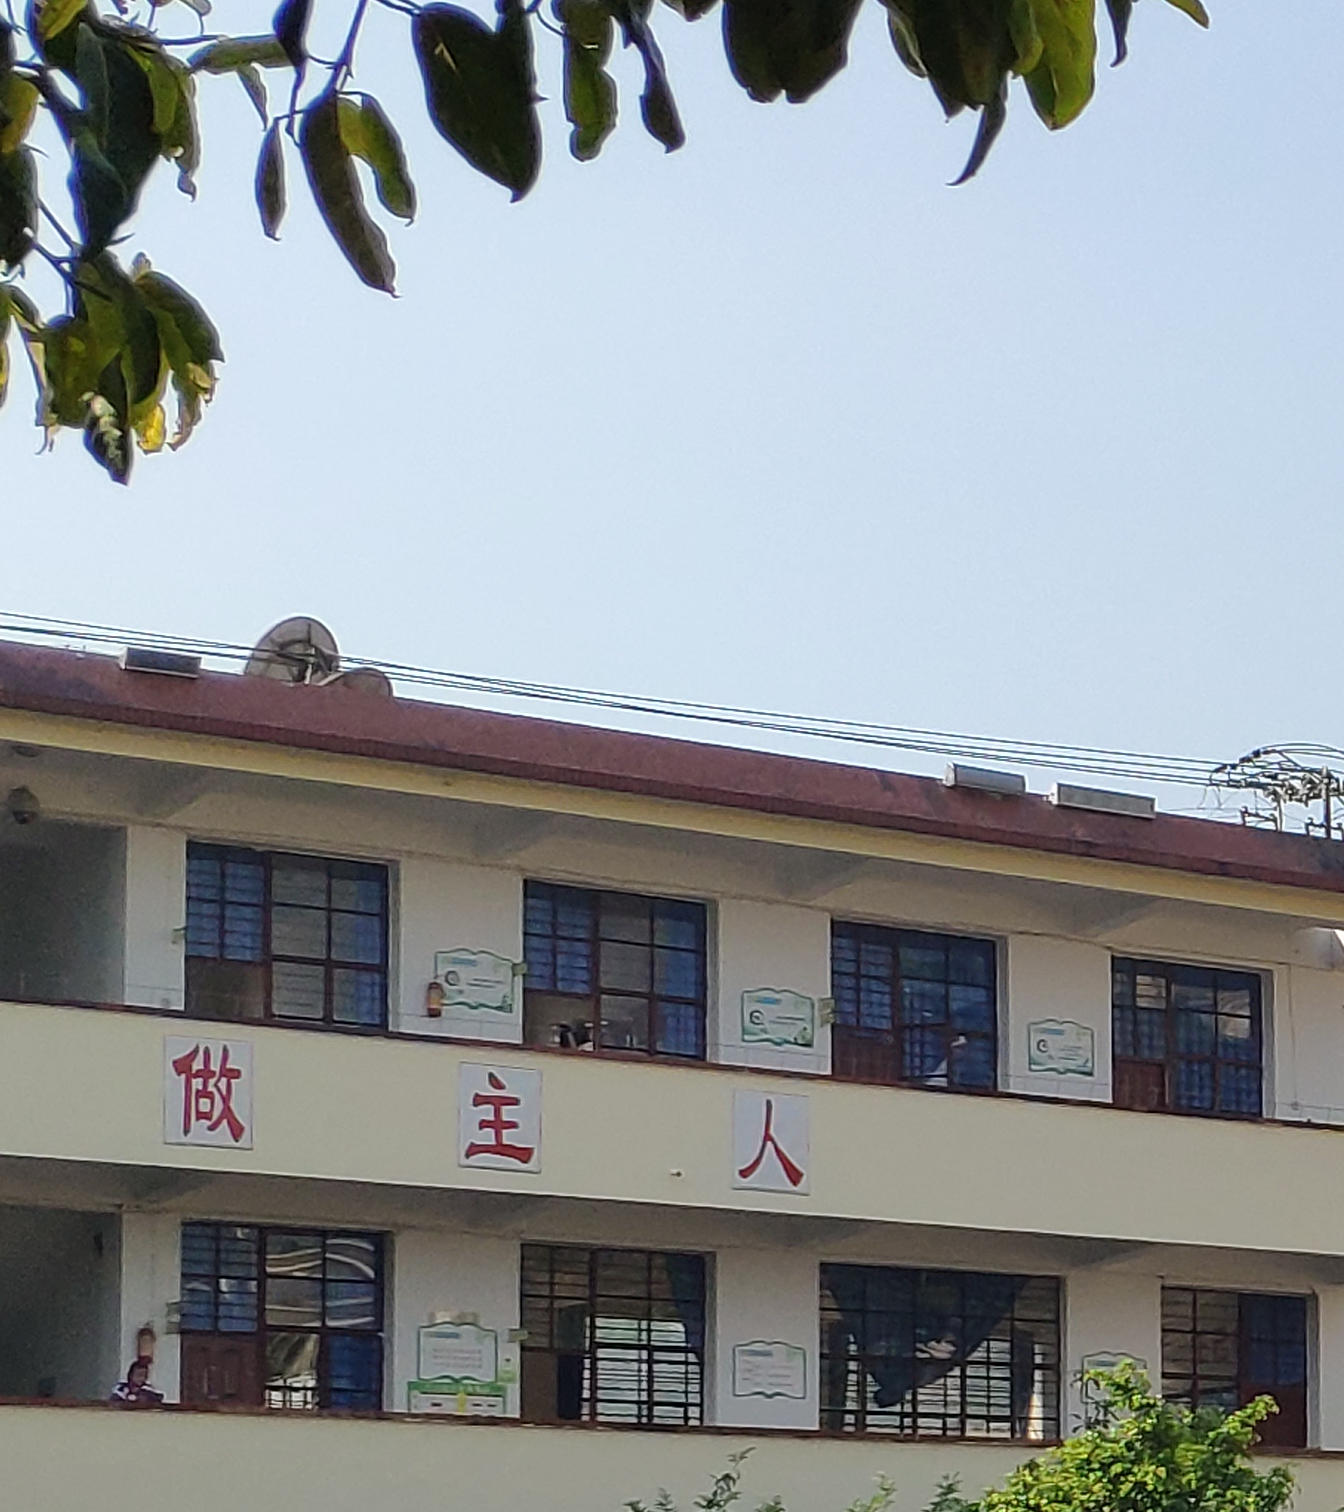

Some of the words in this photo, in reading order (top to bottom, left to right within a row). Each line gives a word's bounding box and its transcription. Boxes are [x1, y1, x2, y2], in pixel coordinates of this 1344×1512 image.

[171, 1042, 245, 1143] 做
[463, 1071, 535, 1164] 主
[738, 1099, 805, 1188] 人
